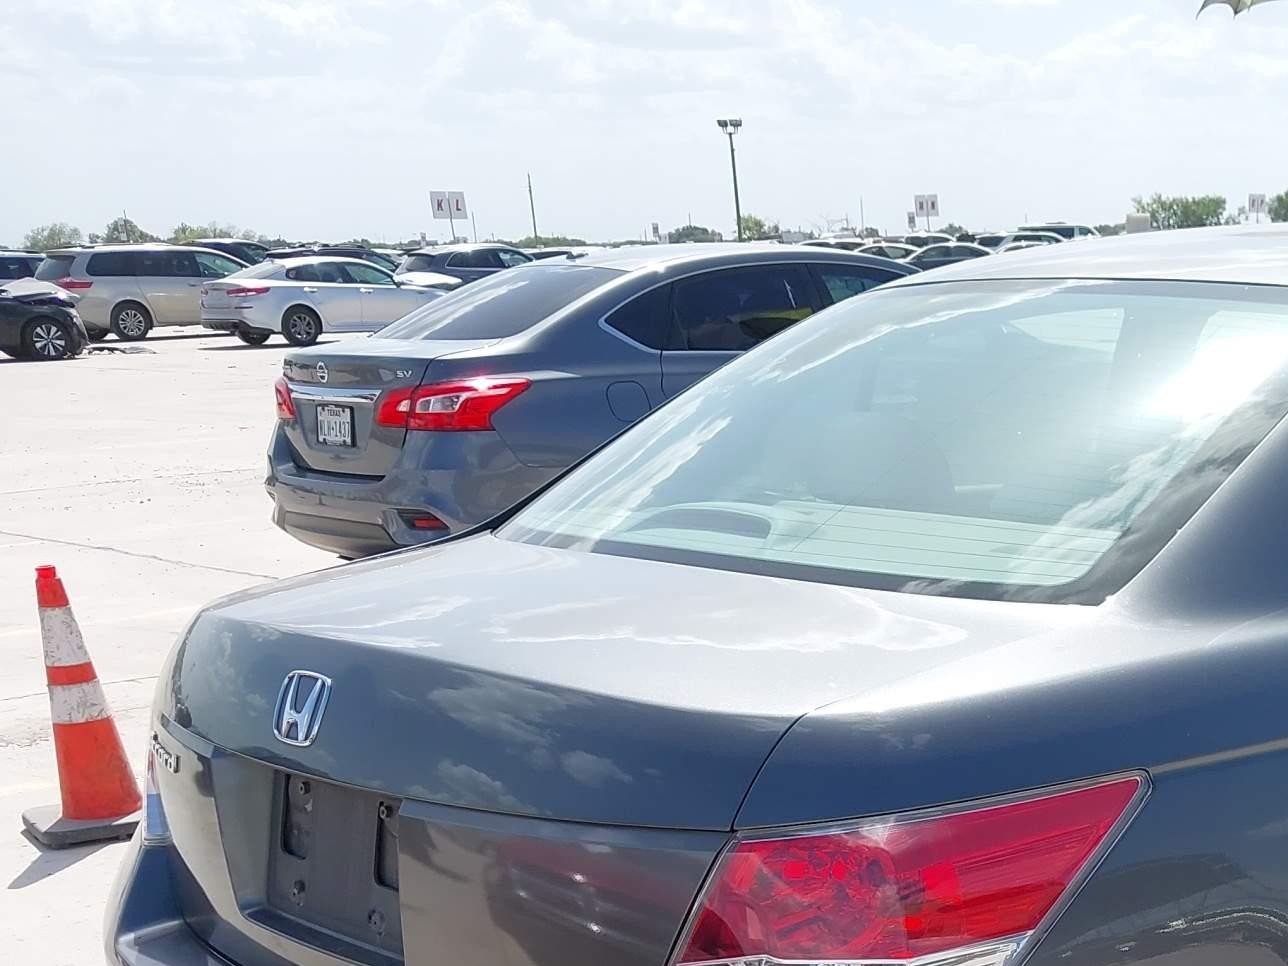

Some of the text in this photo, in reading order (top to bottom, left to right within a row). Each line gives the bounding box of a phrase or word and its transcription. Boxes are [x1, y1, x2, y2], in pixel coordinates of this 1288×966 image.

[436, 199, 444, 211] K
[455, 199, 462, 211] L
[396, 370, 412, 378] SV
